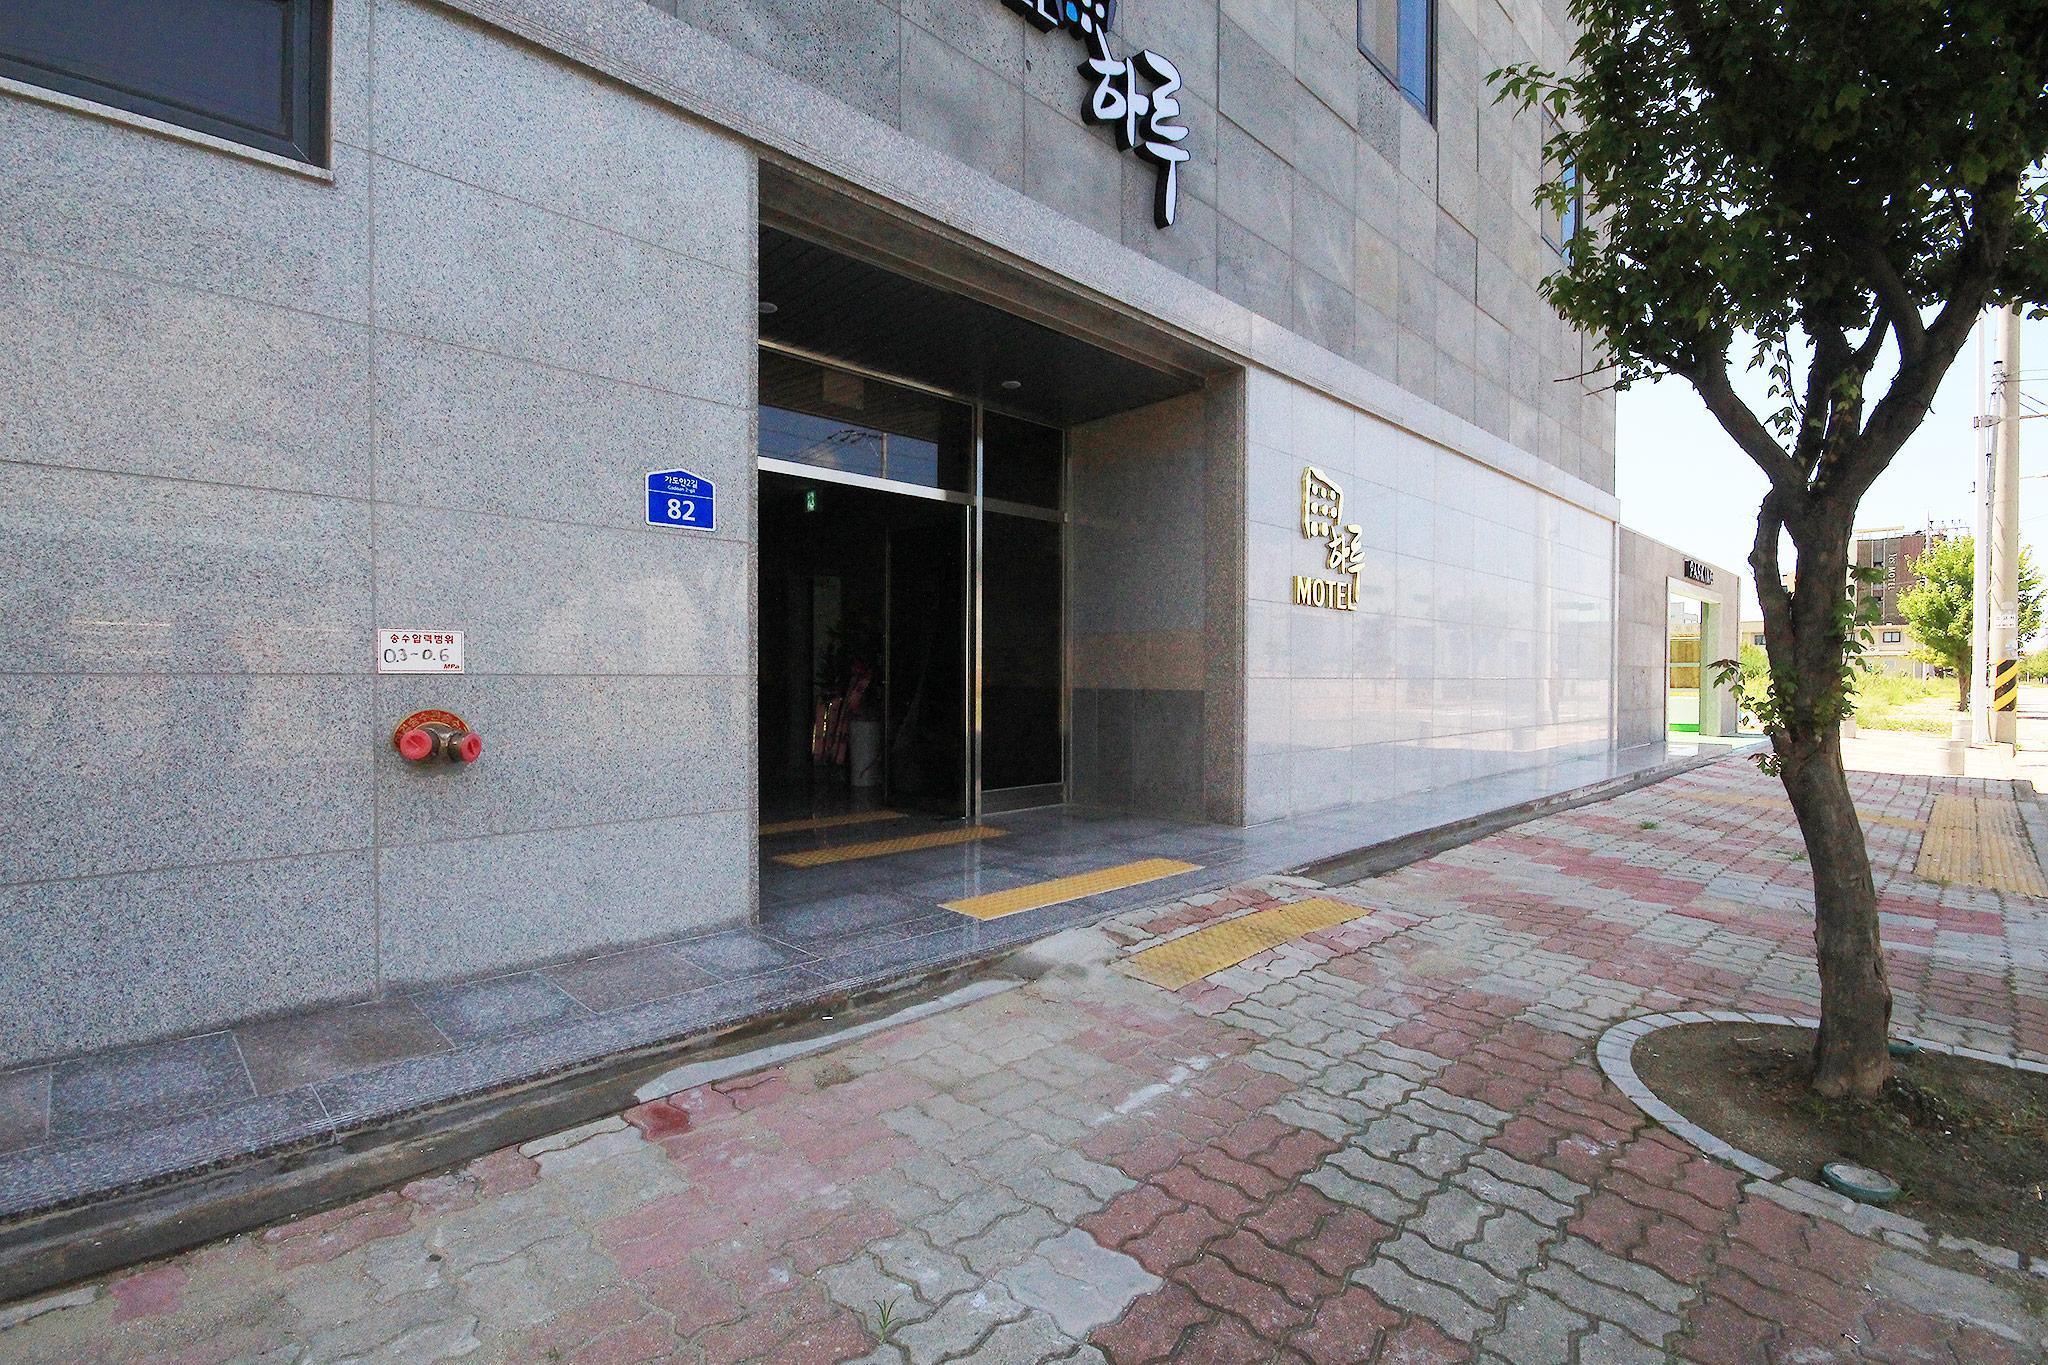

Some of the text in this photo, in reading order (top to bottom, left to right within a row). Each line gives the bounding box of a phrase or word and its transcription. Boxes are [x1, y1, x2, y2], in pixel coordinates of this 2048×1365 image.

[664, 475, 698, 489] 가도안2길
[668, 499, 695, 521] 82
[1887, 566, 1897, 591] MOTEL
[1293, 575, 1359, 611] MOTEL
